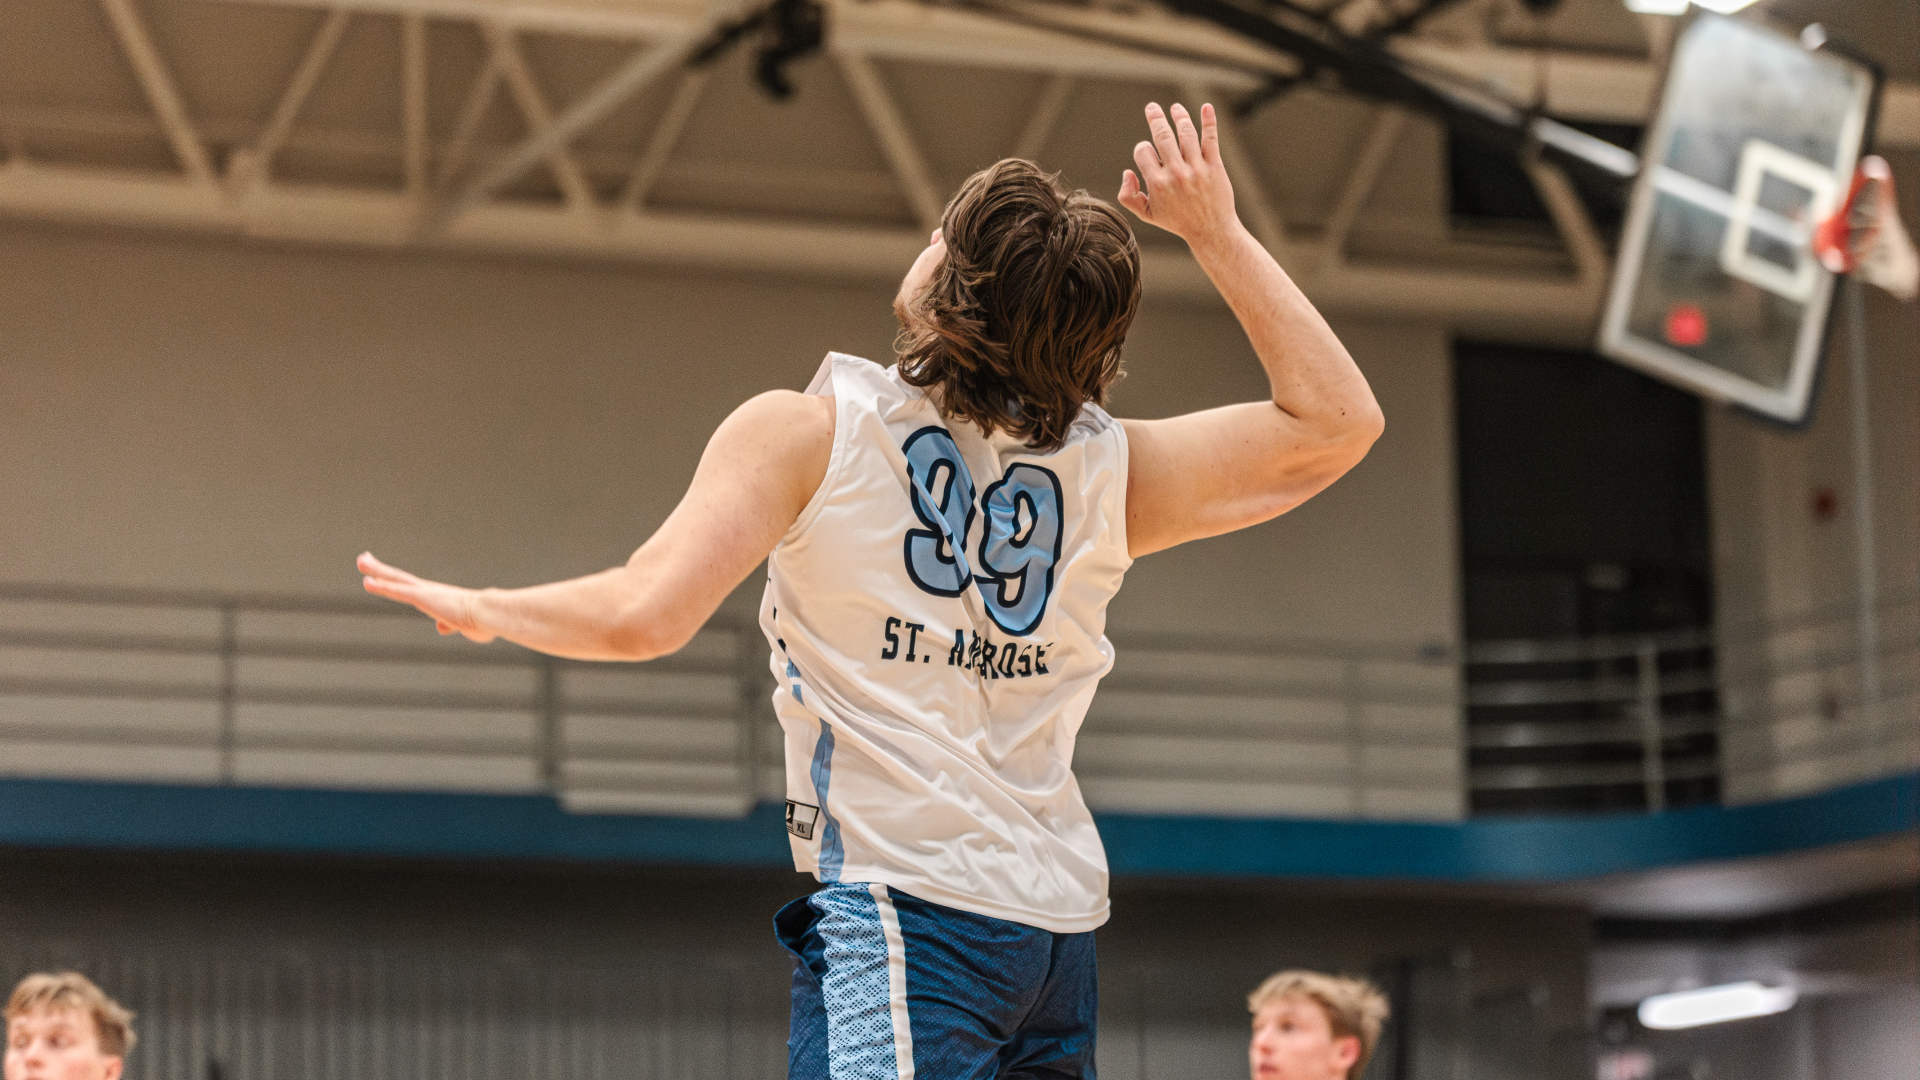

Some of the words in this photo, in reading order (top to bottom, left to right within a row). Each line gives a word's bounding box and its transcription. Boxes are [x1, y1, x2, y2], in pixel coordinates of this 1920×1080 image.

[902, 425, 1064, 637] 99
[881, 616, 930, 663] ST.
[948, 629, 1054, 680] AROSE
[796, 822, 805, 834] XL
